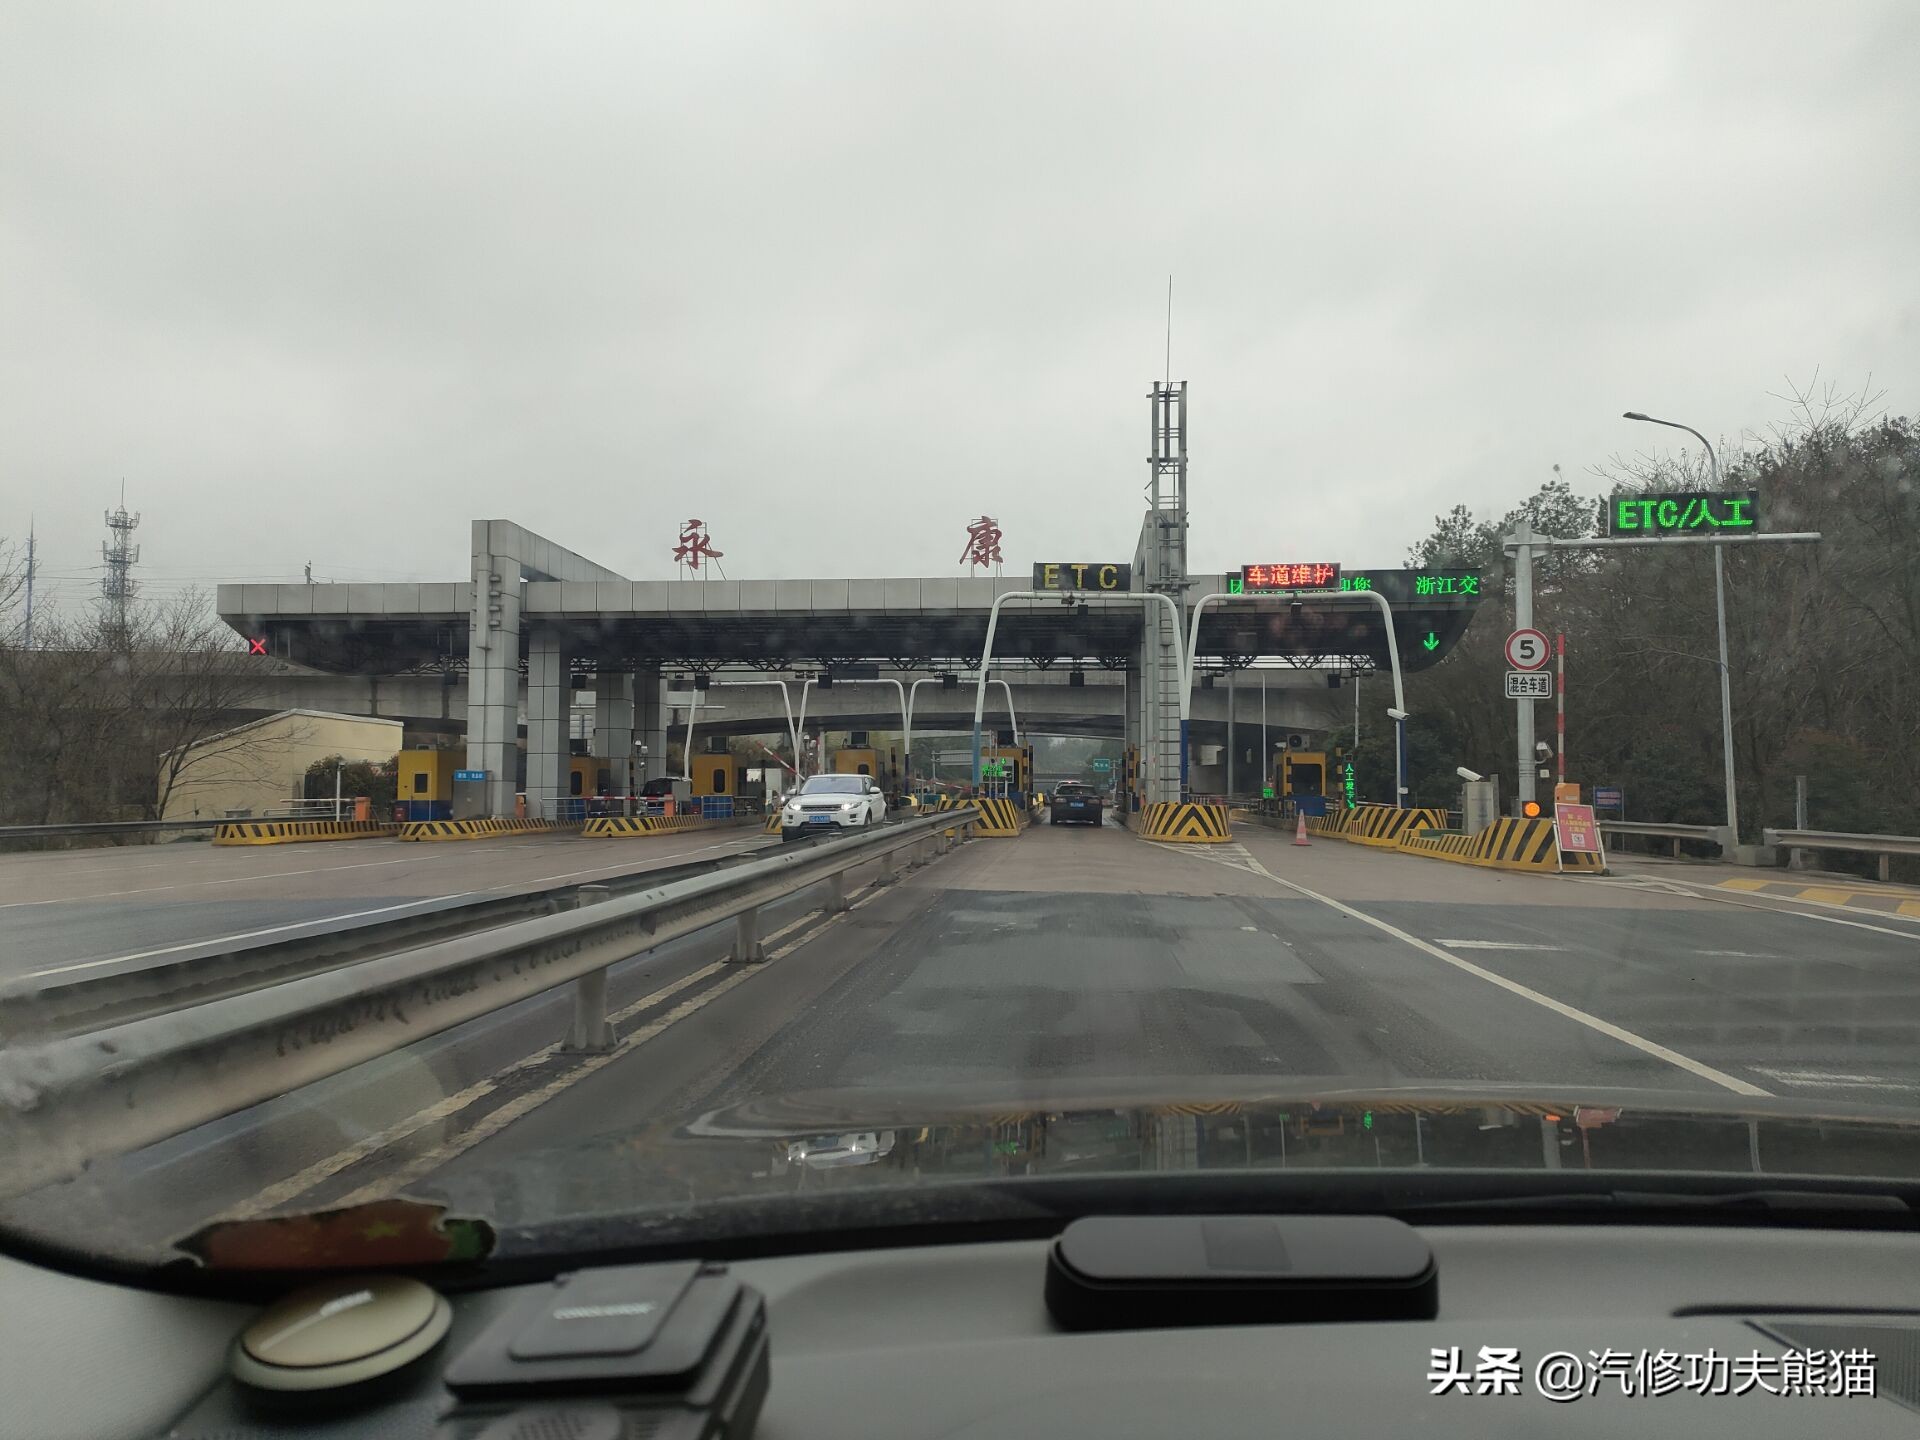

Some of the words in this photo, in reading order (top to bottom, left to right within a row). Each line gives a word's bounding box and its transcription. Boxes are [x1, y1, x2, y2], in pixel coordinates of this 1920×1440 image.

[1617, 498, 1754, 529] ETC/人工
[1043, 564, 1118, 590] ETC
[1247, 563, 1334, 586] 车道维护
[1415, 575, 1480, 595] 浙江交
[1519, 639, 1536, 660] 5
[1509, 676, 1548, 694] 混合车道
